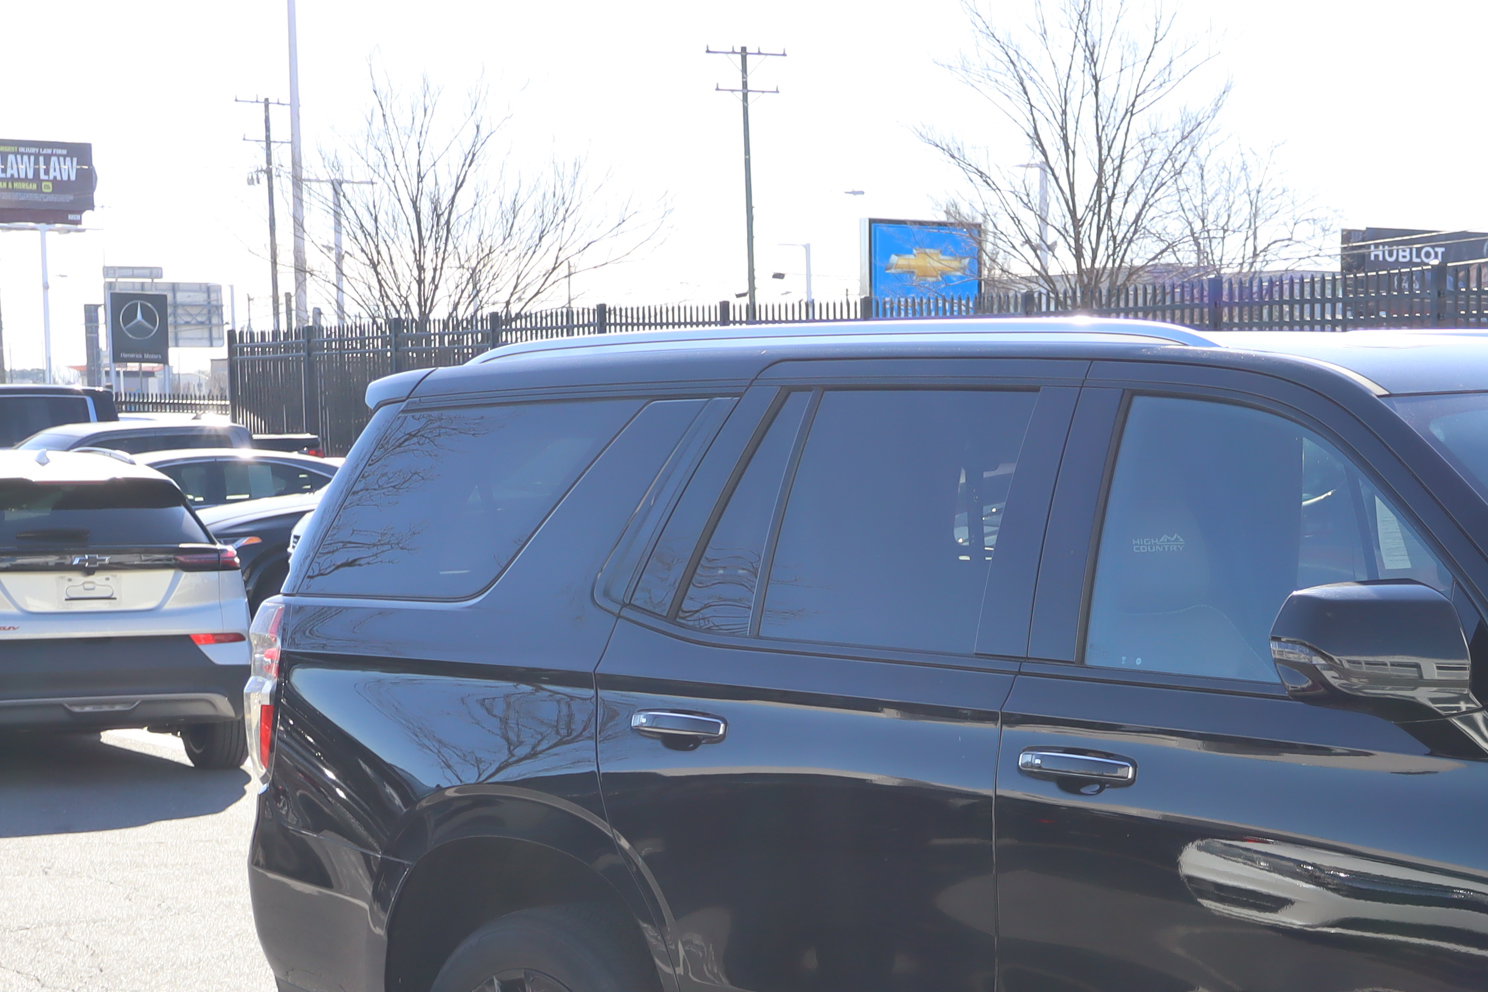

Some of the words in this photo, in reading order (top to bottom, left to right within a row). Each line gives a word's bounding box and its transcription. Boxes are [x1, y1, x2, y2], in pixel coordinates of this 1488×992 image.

[39, 156, 77, 181] LAW
[13, 182, 37, 190] MORGAN
[1370, 244, 1445, 262] HUBLOT
